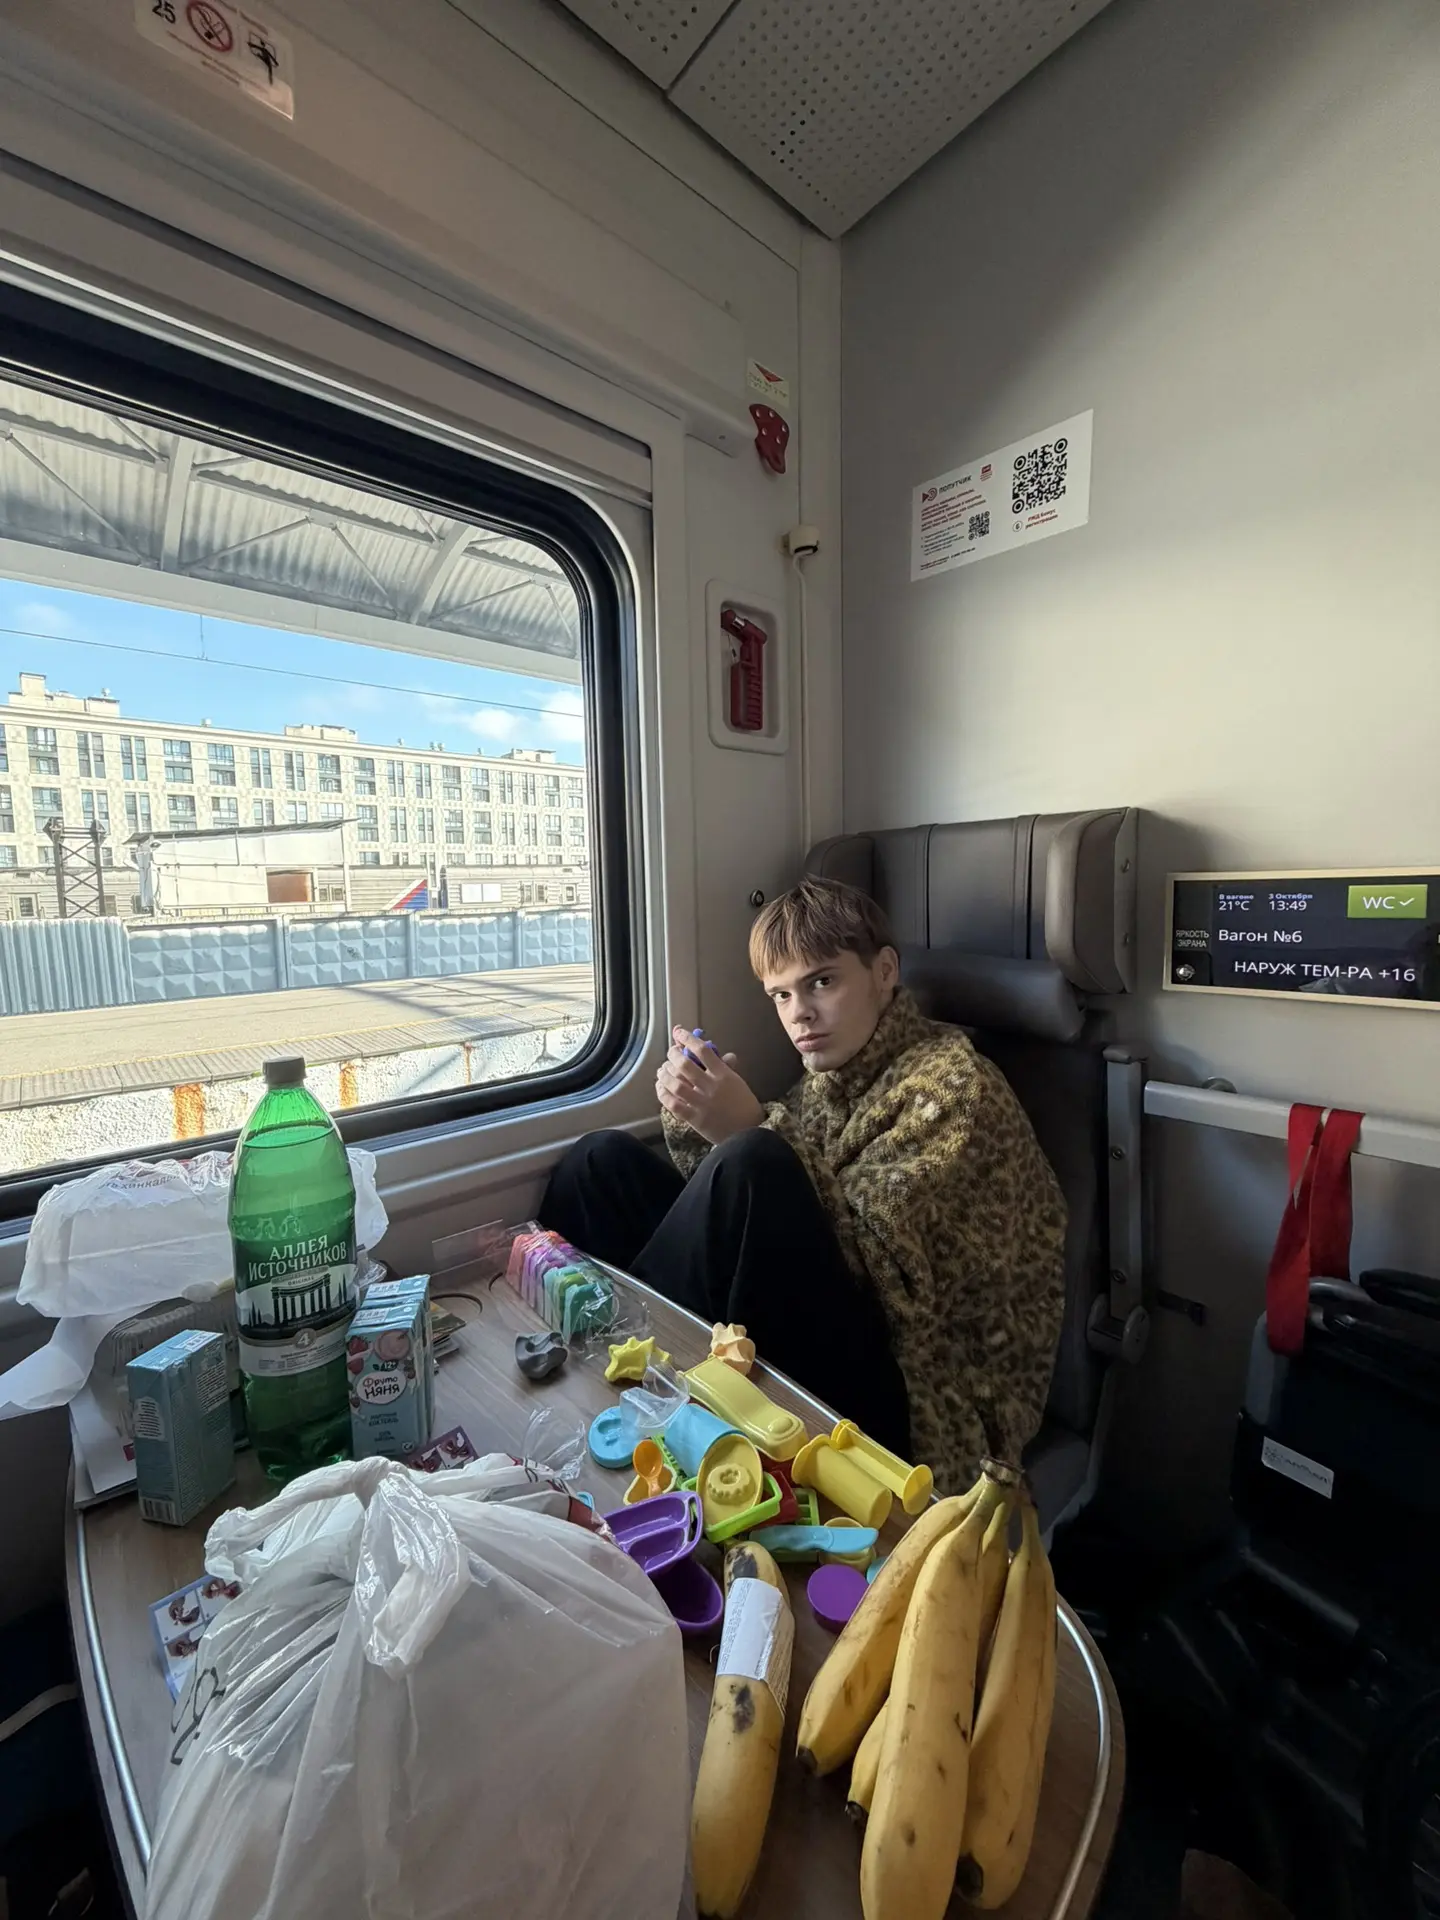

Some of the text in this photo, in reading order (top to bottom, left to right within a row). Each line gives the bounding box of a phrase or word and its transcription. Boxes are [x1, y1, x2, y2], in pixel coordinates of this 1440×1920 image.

[1275, 892, 1313, 901] Октября
[1362, 896, 1396, 910] WC
[1218, 900, 1250, 911] 21°C
[1269, 900, 1307, 911] 13:49
[1175, 929, 1210, 939] ЯРКОСТЬ
[1218, 929, 1303, 943] Вагон №6
[1177, 939, 1207, 948] ЭКРАНА
[1234, 961, 1416, 982] НАРУЖ ТЕМ-РА +16
[269, 1234, 328, 1261] АЛЛЕЯ
[248, 1241, 347, 1282] ИСТОЧНИКОВ
[298, 1332, 311, 1346] 4
